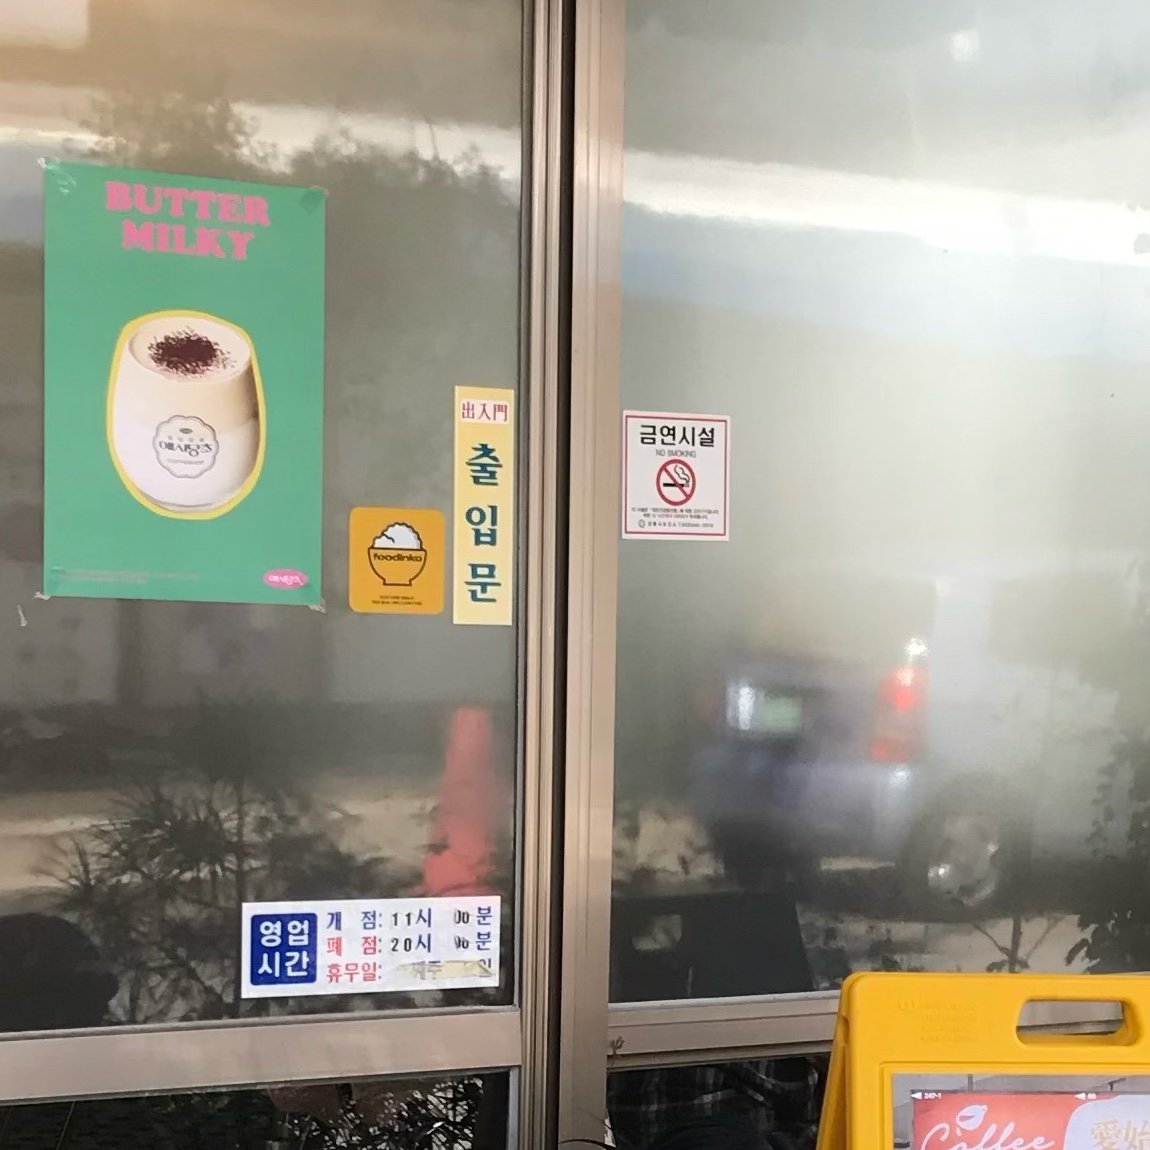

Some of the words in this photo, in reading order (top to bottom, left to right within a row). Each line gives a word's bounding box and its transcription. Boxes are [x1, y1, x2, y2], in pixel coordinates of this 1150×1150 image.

[105, 180, 271, 227] BUTTER
[122, 219, 255, 261] MILKY
[461, 401, 508, 422] 出入門
[639, 424, 716, 448] 금연시설
[655, 449, 667, 458] NO
[667, 449, 697, 458] SMOKING
[464, 443, 503, 603] 출입문
[260, 919, 310, 948] 영업
[257, 950, 310, 978] 시간
